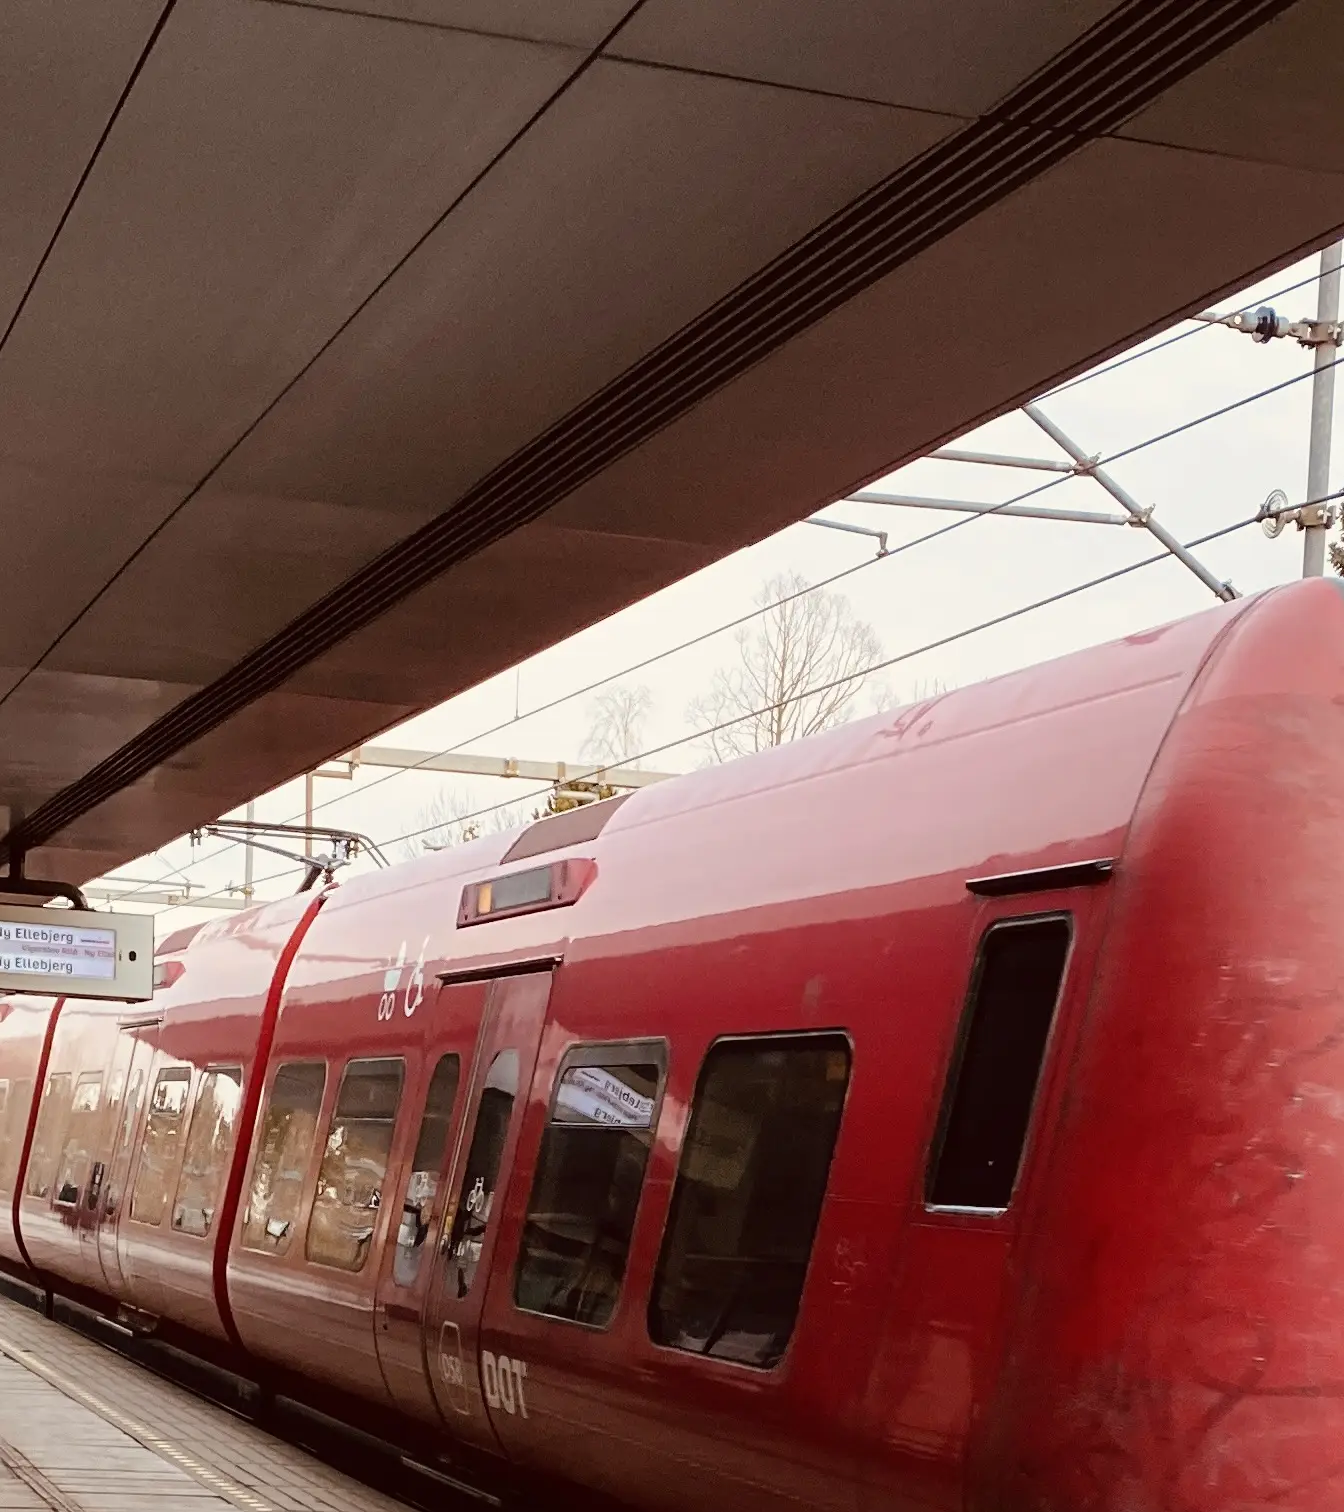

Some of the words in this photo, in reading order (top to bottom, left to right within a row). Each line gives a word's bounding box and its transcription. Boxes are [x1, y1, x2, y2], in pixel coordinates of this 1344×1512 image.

[15, 928, 74, 945] Ellebjerg
[15, 957, 73, 974] Ellebjerg
[481, 1349, 529, 1419] DOT
